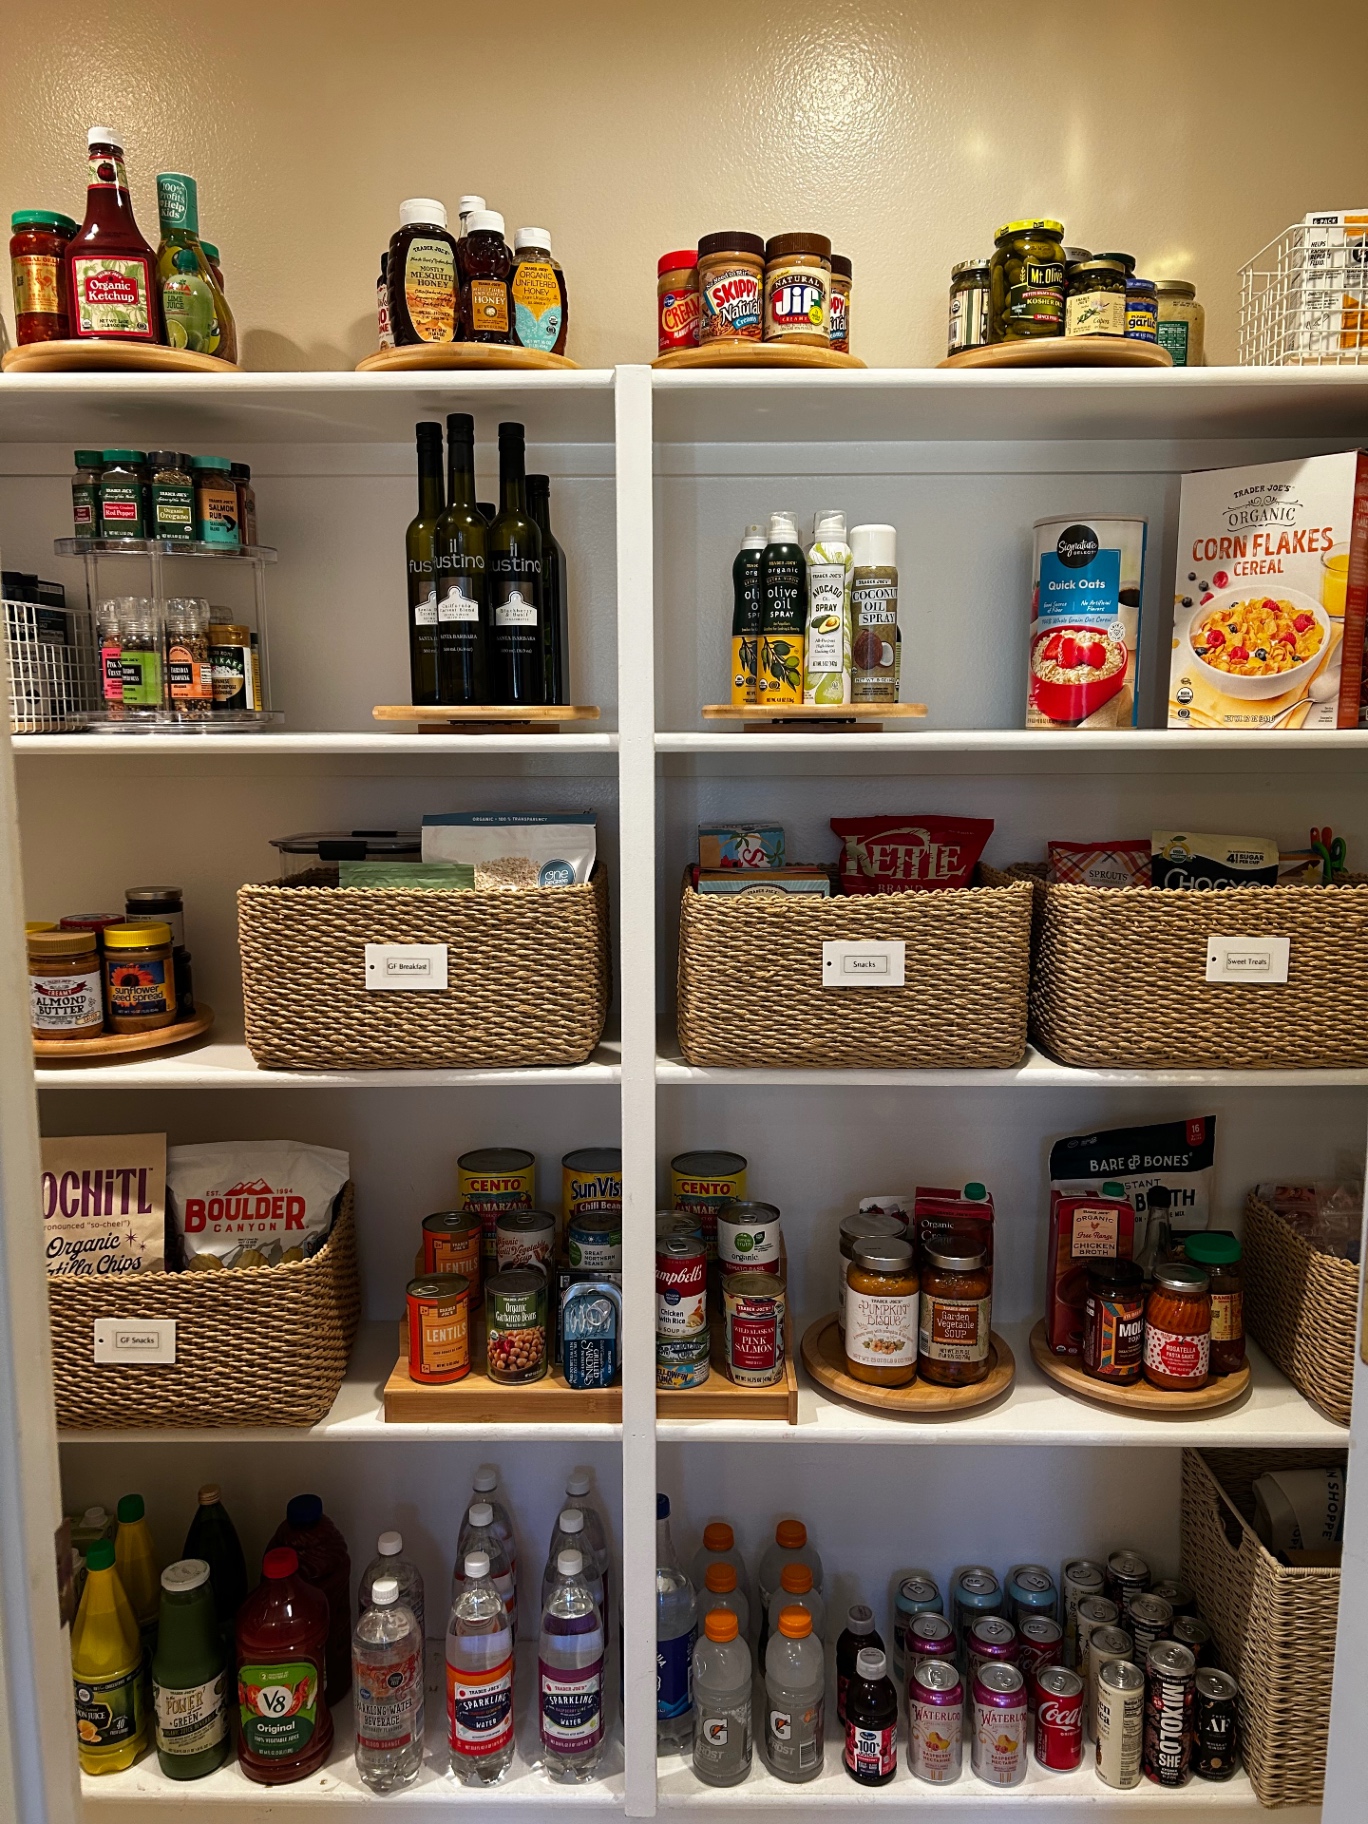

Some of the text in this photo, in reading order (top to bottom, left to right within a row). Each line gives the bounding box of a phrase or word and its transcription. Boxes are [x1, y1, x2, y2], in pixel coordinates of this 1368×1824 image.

[161, 208, 180, 219] Kids
[434, 246, 450, 255] JOE'S
[410, 271, 453, 282] MESQUITE
[520, 270, 552, 280] ORGANIC
[1031, 268, 1063, 284] Mt. Olive
[90, 280, 131, 291] Organic
[417, 279, 449, 288] HONEY
[515, 280, 557, 289] UNFILTERED
[774, 274, 820, 289] NATURAL
[88, 291, 135, 303] Ketchup
[524, 287, 550, 296] HONEY
[712, 278, 758, 308] SKIPPY
[168, 295, 184, 303] LIME
[474, 296, 506, 305] HONEY
[775, 285, 820, 315] Jif
[1027, 297, 1054, 306] KOSHER
[665, 295, 699, 330] CREAM
[720, 296, 761, 322] Natural
[735, 317, 758, 328] Creamy
[1128, 319, 1156, 329] garlic
[1233, 484, 1292, 499] TRADER JOE'S
[117, 510, 135, 518] Pepper
[209, 504, 234, 513] SALMON
[159, 512, 189, 521] Oregano
[209, 512, 222, 520] RUB
[1228, 506, 1296, 526] ORGANIC
[450, 538, 457, 553] il
[510, 543, 518, 557] il
[1058, 539, 1098, 558] Signature
[1192, 526, 1334, 562] CORN FLAKES
[767, 567, 799, 575] organic
[1233, 558, 1284, 577] CEREAL
[1048, 579, 1106, 591] Quick Oats
[767, 587, 798, 599] olive
[812, 584, 843, 599] AVOCADO
[852, 588, 898, 601] COCONUT
[773, 597, 791, 610] oil
[815, 603, 838, 612] SPRAY
[864, 601, 885, 612] OIL
[769, 611, 794, 619] SPRAY
[862, 613, 895, 624] SPRAY
[1052, 617, 1068, 625] Whole
[1095, 616, 1113, 624] Cereal
[840, 828, 968, 881] KETTLE
[544, 869, 569, 881] one
[1089, 870, 1129, 881] SPROUTS
[878, 883, 924, 893] BRAND
[399, 962, 427, 970] Breakfast
[852, 959, 876, 969] Snacks
[1227, 957, 1268, 967] Sweet Treats
[47, 988, 72, 997] CREAMY
[114, 985, 159, 996] sunflower
[36, 995, 87, 1007] ALMOND
[112, 991, 164, 1003] seed spread
[39, 1005, 85, 1015] BUTTER
[1191, 1123, 1200, 1134] 16
[1090, 1155, 1190, 1172] BARE BONES
[470, 1178, 522, 1192] CENTO
[681, 1181, 731, 1195] CENTO
[1124, 1178, 1162, 1190] STANT
[41, 1168, 152, 1220] OCHiTL
[1135, 1188, 1196, 1212] BTH
[464, 1201, 529, 1212] SAN MARZANO
[580, 1201, 622, 1212] Chili Bean
[184, 1194, 306, 1233] BOULDER
[1076, 1214, 1114, 1223] ORGANIC
[213, 1222, 278, 1232] CANYON
[921, 1219, 954, 1229] Organic
[1093, 1232, 1114, 1240] Range
[46, 1232, 122, 1259] Organic
[1073, 1242, 1115, 1250] CHICKEN
[96, 1254, 142, 1275] Chips
[440, 1258, 478, 1273] LENTILS
[726, 1263, 747, 1272] TOMATO
[655, 1264, 702, 1286] ampbell's
[505, 1302, 527, 1314] Organic
[660, 1308, 684, 1318] Chicken
[859, 1301, 910, 1316] PUMPKIN
[495, 1312, 537, 1324] Garbanzo Beans
[659, 1316, 686, 1325] with Rice
[941, 1311, 970, 1322] Garden
[936, 1318, 975, 1330] Vegetable
[426, 1322, 467, 1344] LENTILS
[734, 1327, 775, 1335] WILD ALASKAN
[944, 1329, 967, 1339] SOUP
[120, 1336, 155, 1345] GF Snacks
[742, 1336, 767, 1345] PINK
[735, 1343, 773, 1354] SALMON
[1166, 1345, 1196, 1354] ROSATELLA
[580, 1339, 594, 1386] SARDINES
[1322, 1482, 1340, 1541] SHOPPE
[165, 1691, 204, 1716] POWER
[262, 1689, 286, 1714] V8
[463, 1692, 507, 1711] SPARKLING
[549, 1695, 593, 1705] SPARKLING
[390, 1698, 413, 1715] WATER
[912, 1703, 960, 1722] WATERLOO
[88, 1711, 106, 1720] JUICE
[173, 1712, 199, 1728] GREEN
[364, 1714, 400, 1728] BEVERAGE
[978, 1708, 1026, 1727] WATERLOO
[257, 1720, 296, 1735] Original
[476, 1718, 497, 1729] WATER
[560, 1718, 582, 1726] WATER
[770, 1710, 791, 1740] G
[1205, 1718, 1231, 1733] AF
[703, 1718, 728, 1746] G
[1158, 1753, 1182, 1768] SHE
